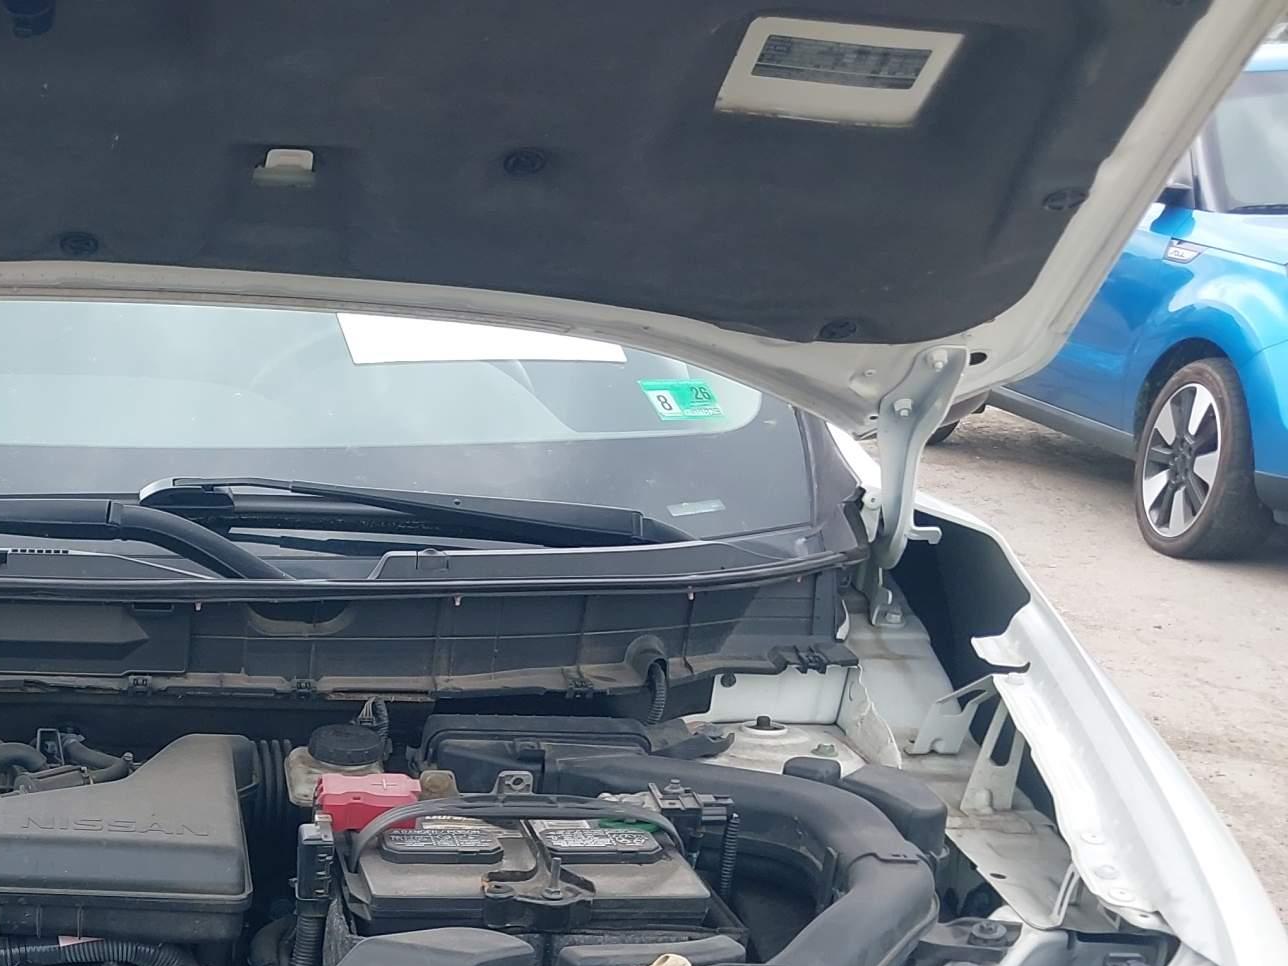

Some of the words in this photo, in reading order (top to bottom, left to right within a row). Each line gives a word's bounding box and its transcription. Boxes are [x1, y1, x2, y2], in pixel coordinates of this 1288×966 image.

[690, 386, 712, 400] 26
[656, 394, 673, 411] 8
[21, 816, 209, 837] NISSAN
